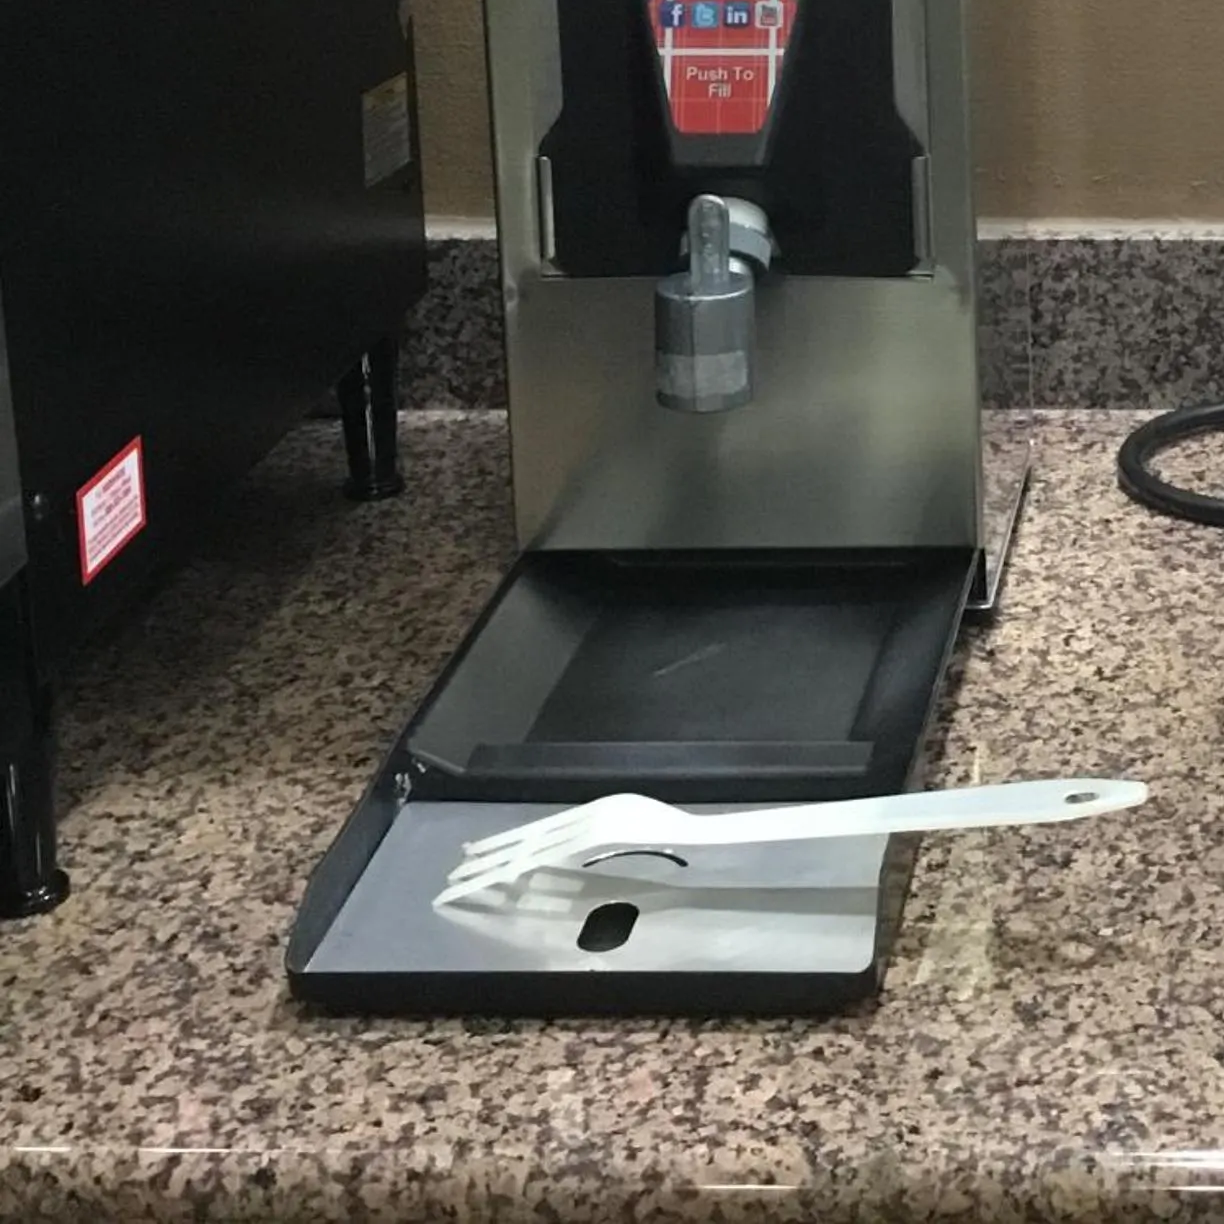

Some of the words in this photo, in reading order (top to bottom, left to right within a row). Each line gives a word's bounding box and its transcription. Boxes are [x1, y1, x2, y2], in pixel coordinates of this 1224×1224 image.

[687, 66, 727, 80] Push
[732, 66, 755, 80] To
[708, 82, 732, 98] Fill
